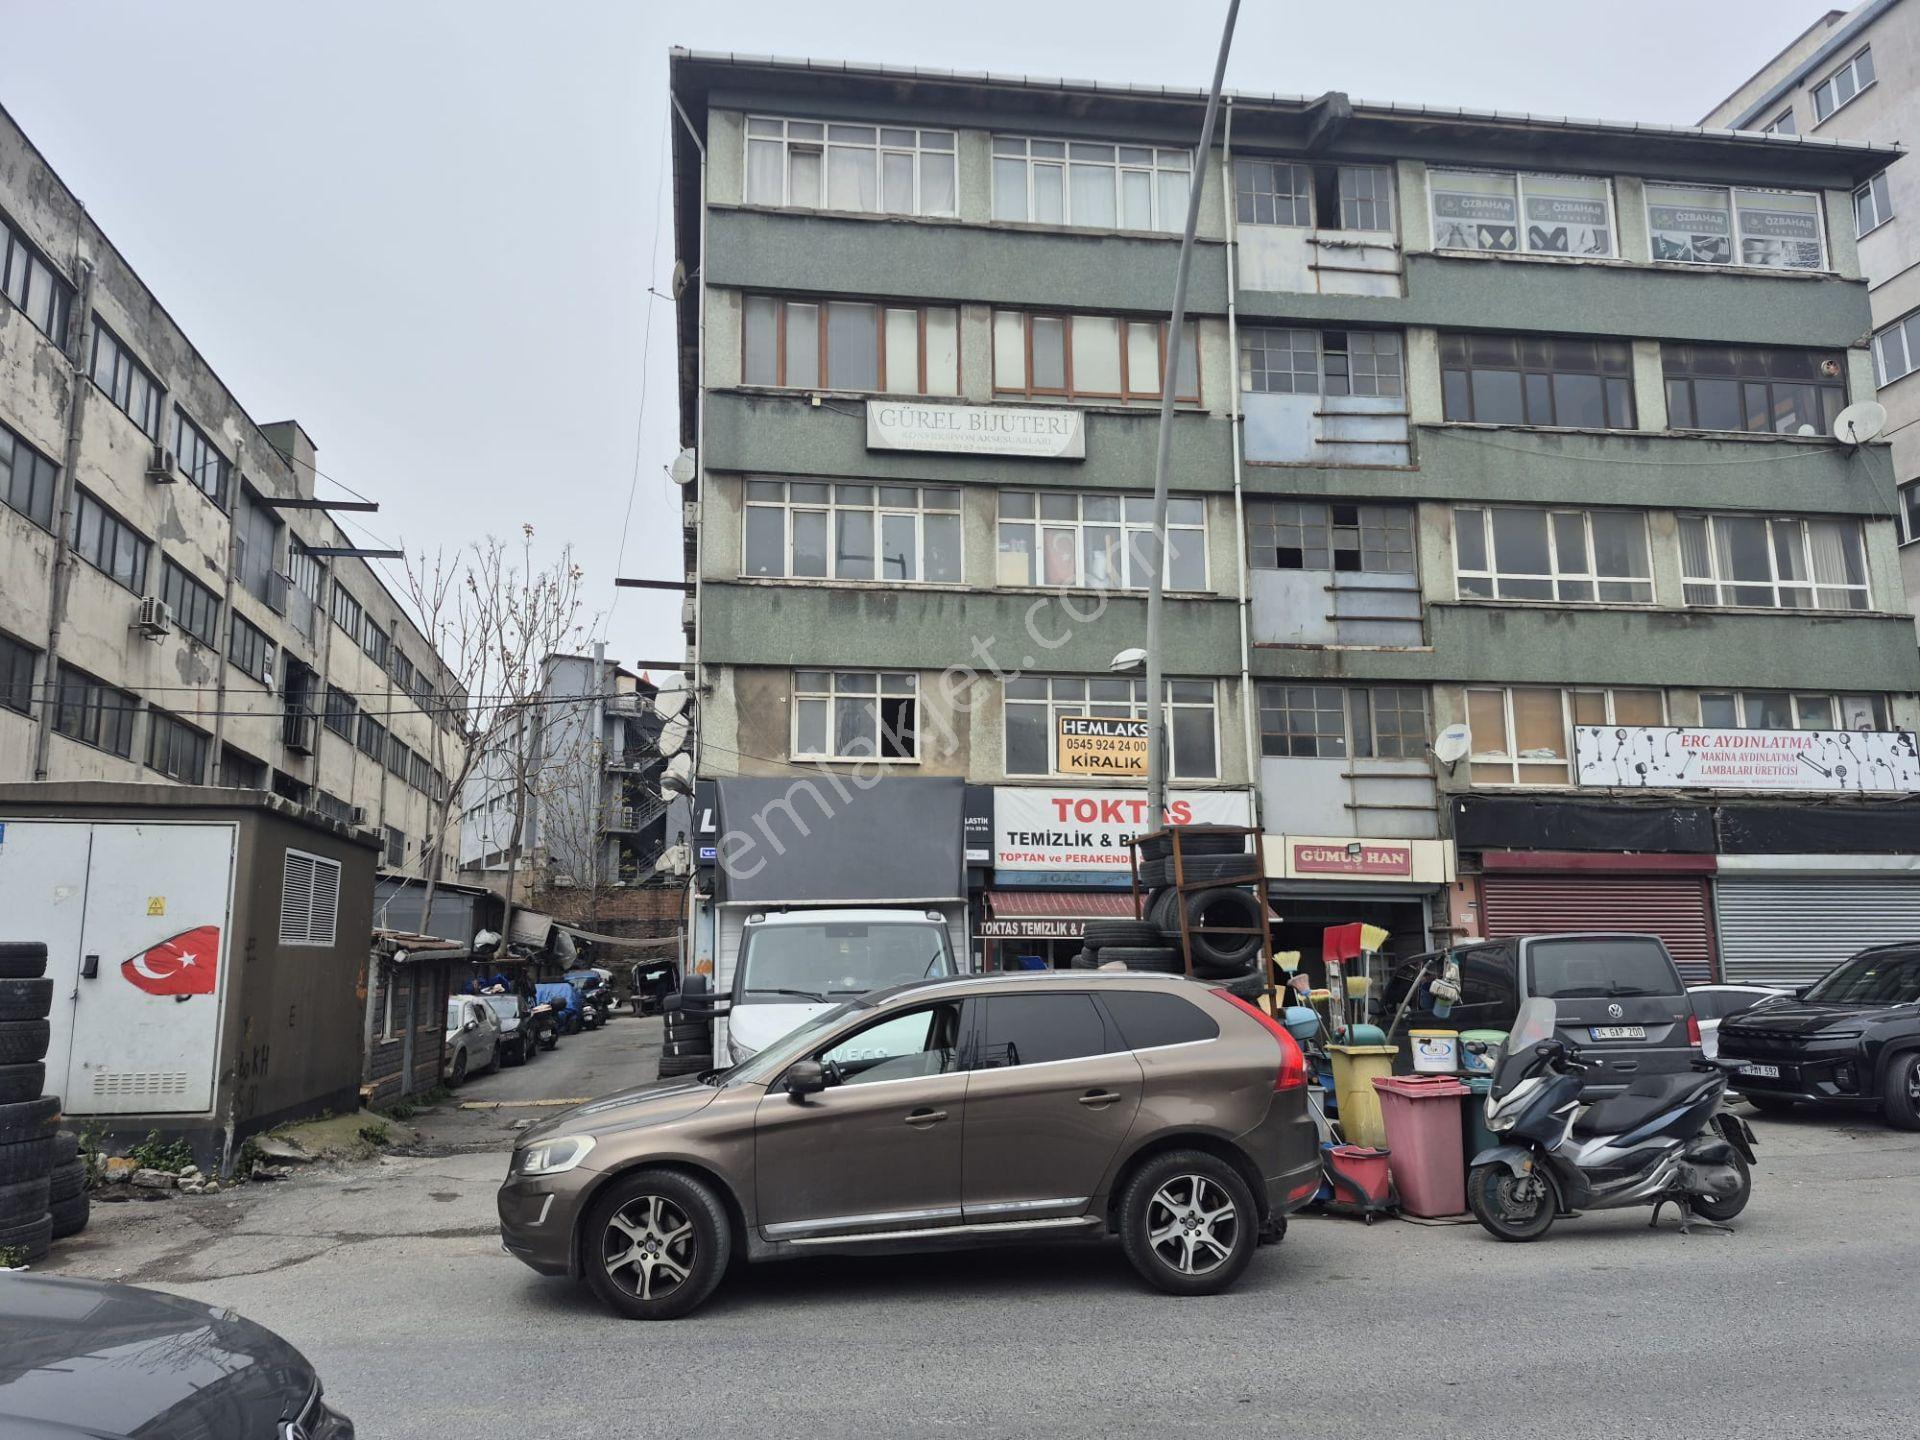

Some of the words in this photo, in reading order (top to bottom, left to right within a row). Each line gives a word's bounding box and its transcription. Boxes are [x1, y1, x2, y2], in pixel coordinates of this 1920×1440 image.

[1461, 198, 1511, 211] ÖZBAHAR
[1552, 202, 1601, 215] ÖZBAHAR
[1676, 211, 1723, 224] ÖZBAHAR
[1765, 215, 1813, 228] ÖZBAHAR
[879, 406, 961, 430] GÜREL
[1066, 738, 1093, 750] 0545
[1096, 739, 1115, 751] 924
[1118, 740, 1131, 752] 24
[1134, 741, 1147, 752] 00
[1681, 735, 1710, 748] ERC
[1714, 735, 1812, 749] AYDINLATMA
[1071, 752, 1142, 769] KİRALIK
[1738, 752, 1795, 763] AYDINLATMA
[1701, 765, 1752, 776] LAMBALARI
[1755, 764, 1798, 776] ÜRETİCİSİ
[1007, 828, 1094, 847] TEMİZLİK
[1100, 832, 1112, 848] &
[999, 853, 1045, 863] TOPTAN
[1049, 855, 1062, 863] ve
[1065, 854, 1133, 864] PERAKEND
[1367, 851, 1404, 864] HAN
[981, 921, 1018, 935] TOKTAS
[1021, 920, 1067, 936] TEMİZLİK
[1070, 923, 1078, 935] &
[1595, 1028, 1606, 1037] 34
